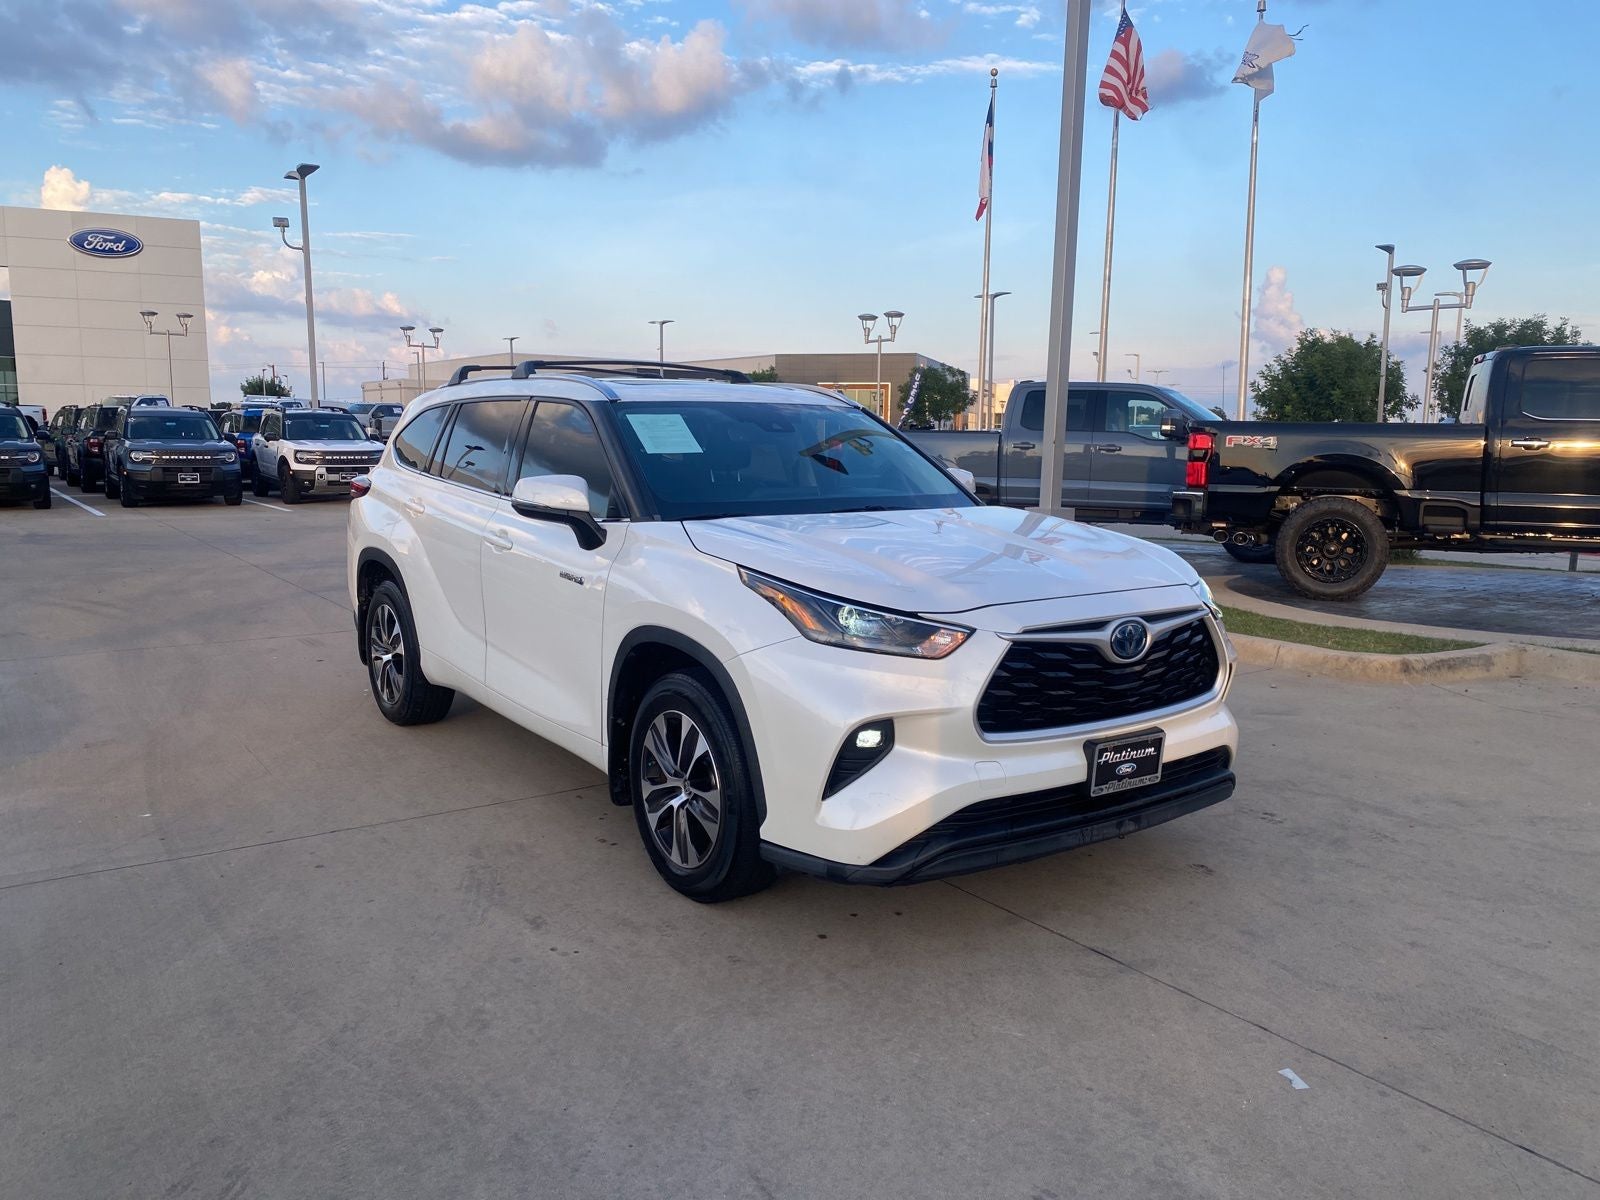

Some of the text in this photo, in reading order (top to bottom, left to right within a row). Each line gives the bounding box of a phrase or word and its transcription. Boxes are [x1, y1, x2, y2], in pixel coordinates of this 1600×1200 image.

[84, 233, 126, 252] Ford
[907, 373, 921, 404] USED
[1226, 435, 1277, 449] FX4
[1098, 747, 1157, 765] Platinum
[1107, 778, 1146, 792] Platinum
